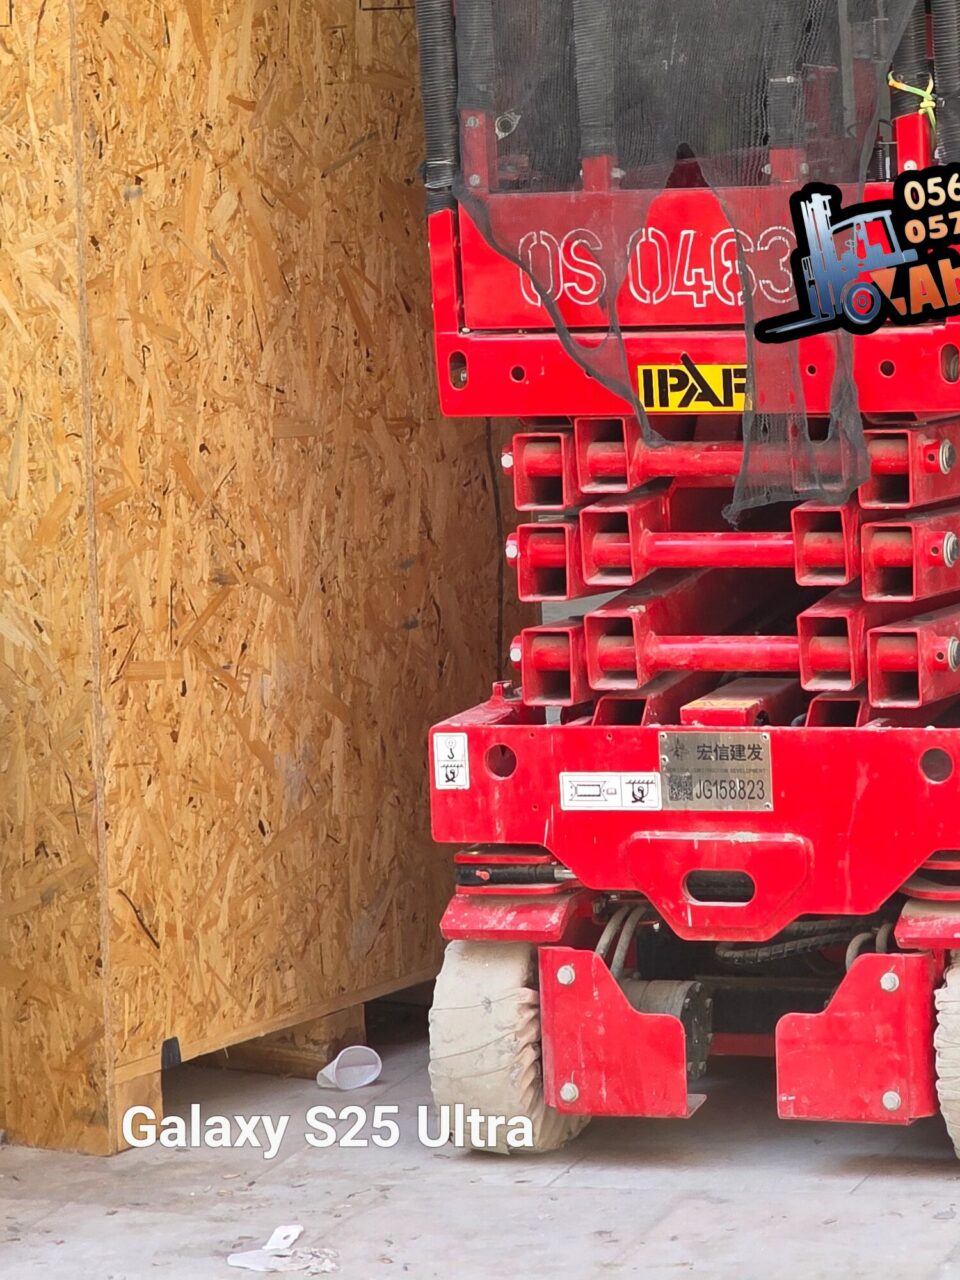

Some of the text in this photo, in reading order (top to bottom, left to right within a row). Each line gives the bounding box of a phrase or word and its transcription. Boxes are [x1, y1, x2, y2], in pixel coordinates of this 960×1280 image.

[642, 352, 747, 408] IPAF
[696, 743, 763, 762] 宏信建发
[695, 779, 765, 800] JG158823
